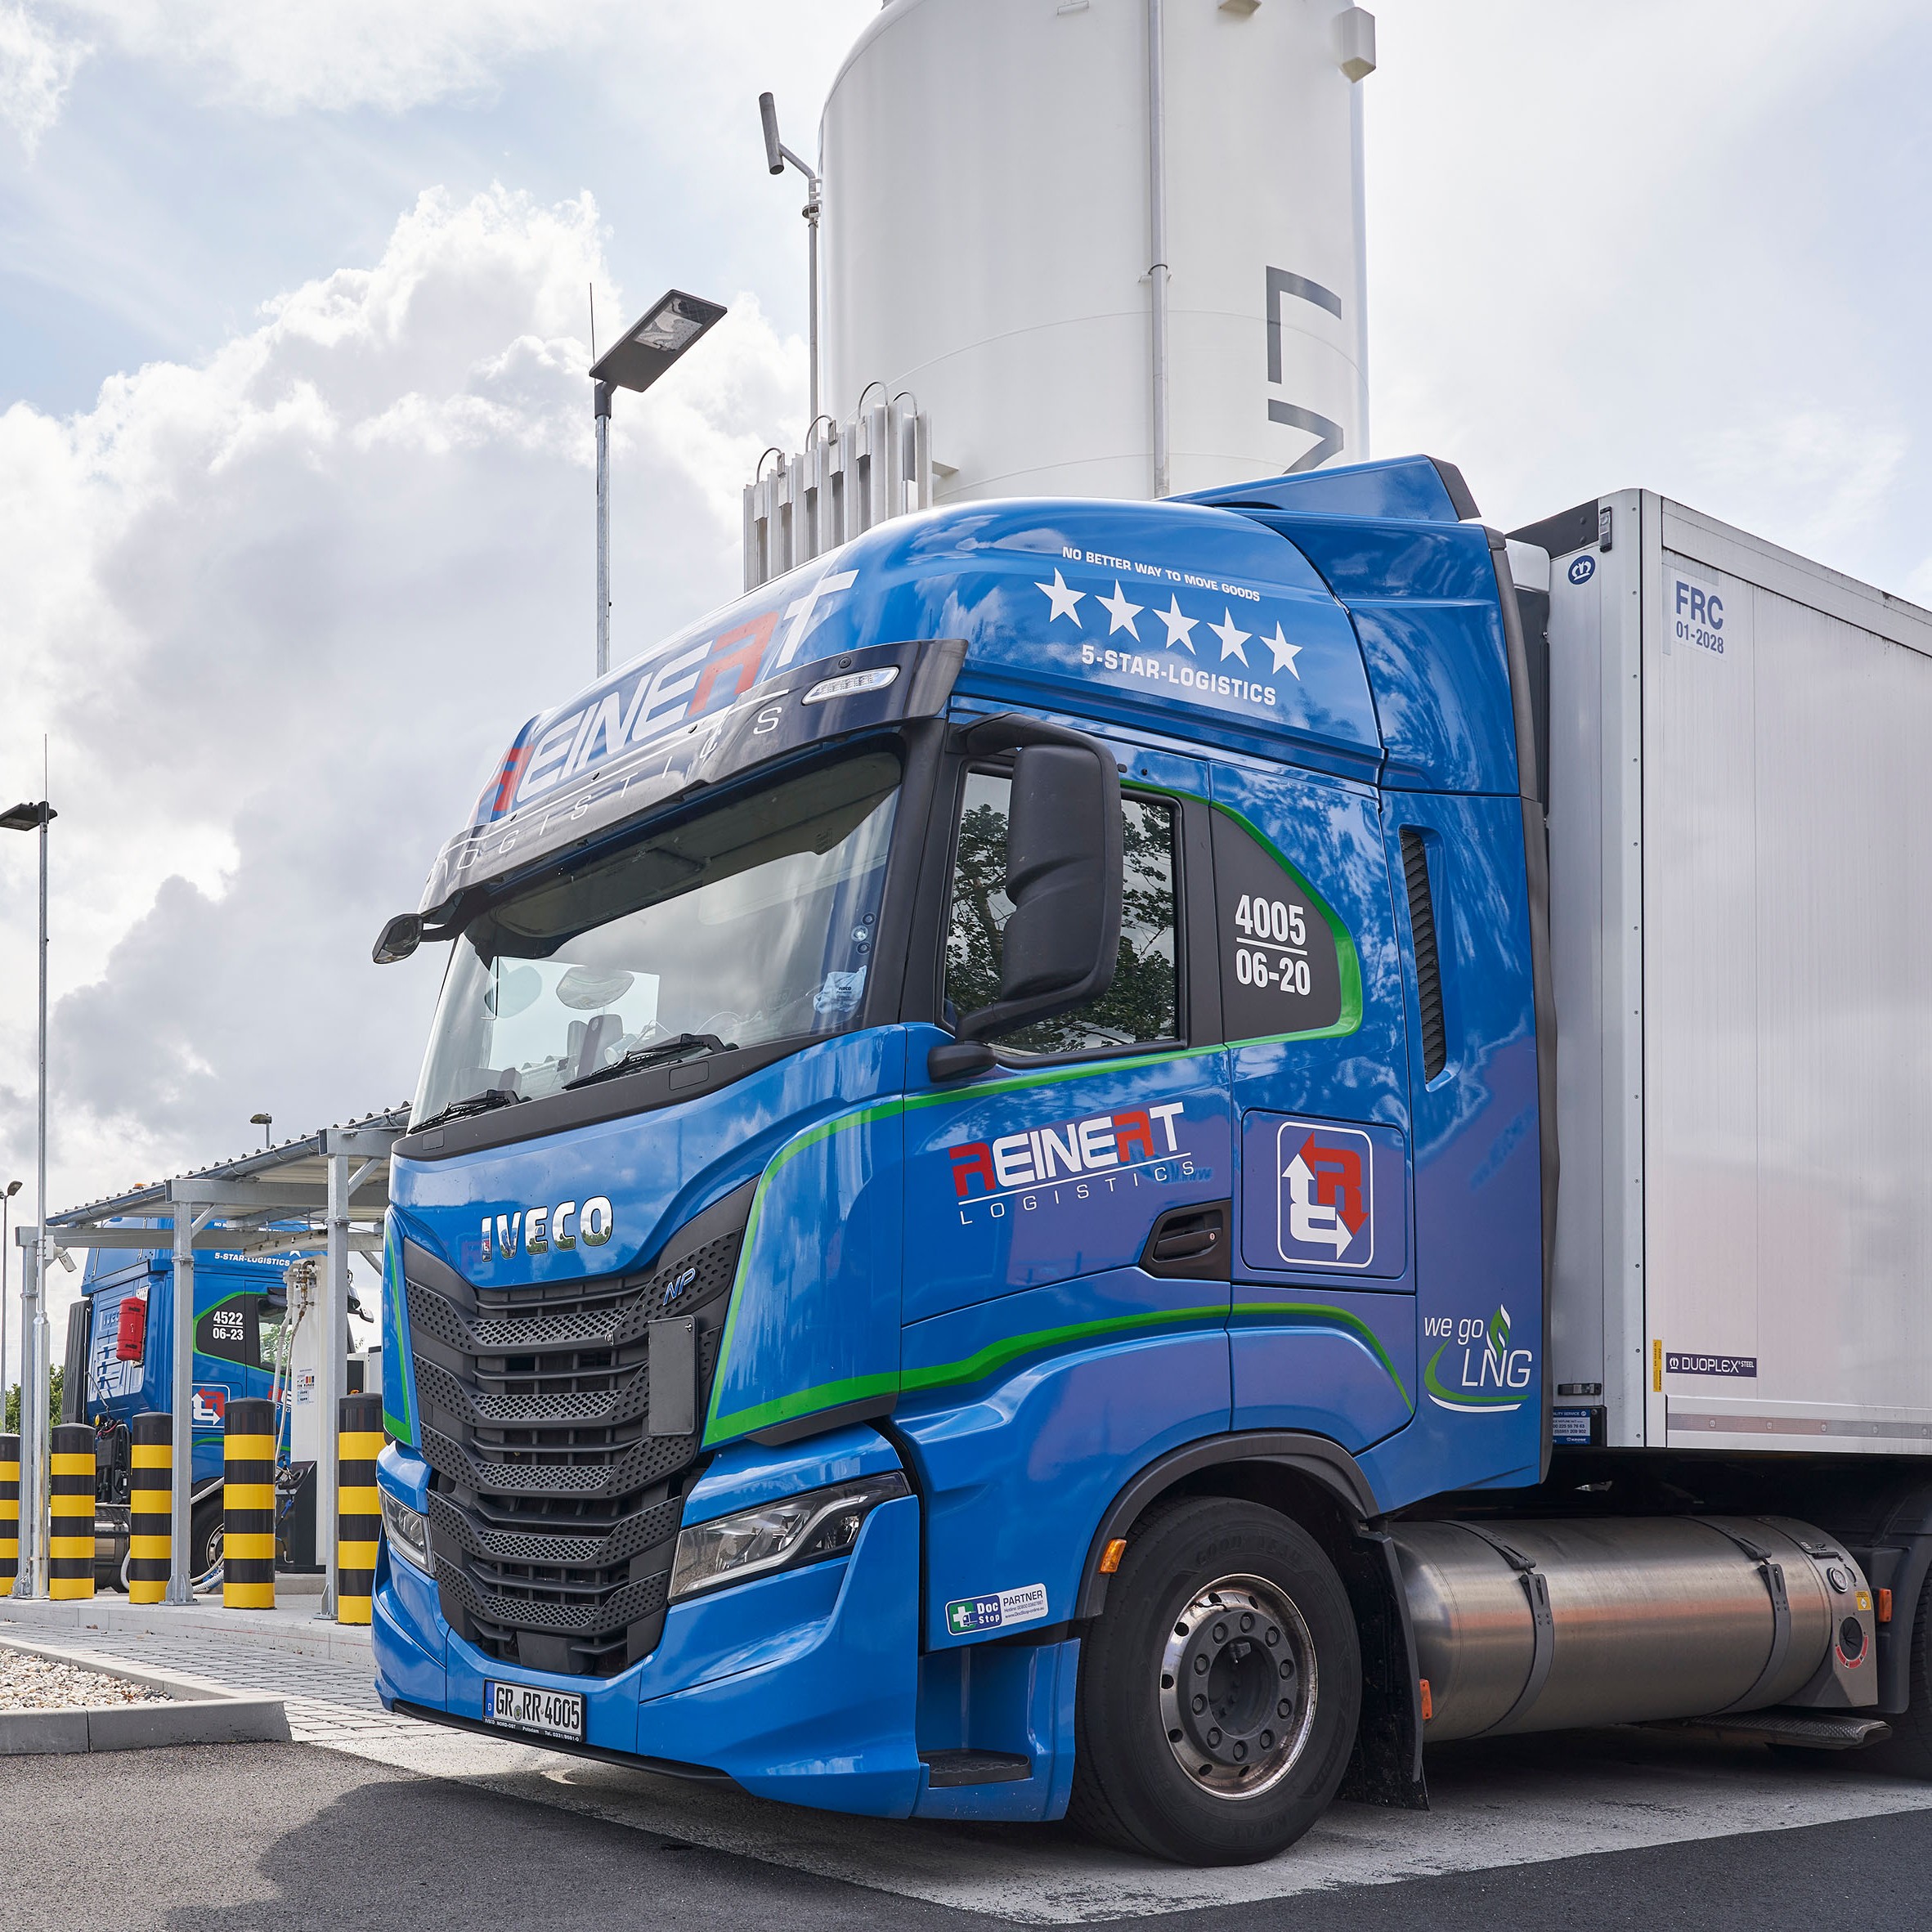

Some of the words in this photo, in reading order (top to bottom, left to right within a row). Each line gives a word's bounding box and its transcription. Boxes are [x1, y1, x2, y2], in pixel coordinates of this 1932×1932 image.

[1063, 547, 1081, 560] NO
[1086, 552, 1131, 571] BETTER
[1135, 563, 1162, 578] WAY
[1165, 570, 1181, 581] TO
[1185, 574, 1218, 590] MOVE
[1222, 583, 1260, 602] GOODS
[1676, 580, 1724, 630] FRC
[1676, 621, 1724, 654] 01-2028
[1082, 644, 1275, 706] 5-STAR-LOGISTICS
[468, 570, 859, 824] REINERT
[1235, 894, 1307, 945] 4005
[1236, 948, 1311, 996] 06-20
[948, 1102, 1185, 1197] REINERT
[960, 1161, 1195, 1225] LOGISTICS
[481, 1195, 613, 1262] IVECO
[214, 1252, 290, 1267] 5-STAR-LOGISTICS
[662, 1267, 696, 1307] NP
[213, 1311, 244, 1325] 4522
[213, 1328, 244, 1341] 06-23
[1424, 1317, 1453, 1337] we
[1458, 1318, 1484, 1345] go
[1462, 1348, 1533, 1388] LNG
[977, 1602, 999, 1615] Doc
[1003, 1589, 1043, 1607] PARTNER
[979, 1614, 1000, 1625] Stop
[496, 1687, 513, 1717] GR
[522, 1692, 541, 1722] RR
[545, 1696, 580, 1730] 4005
